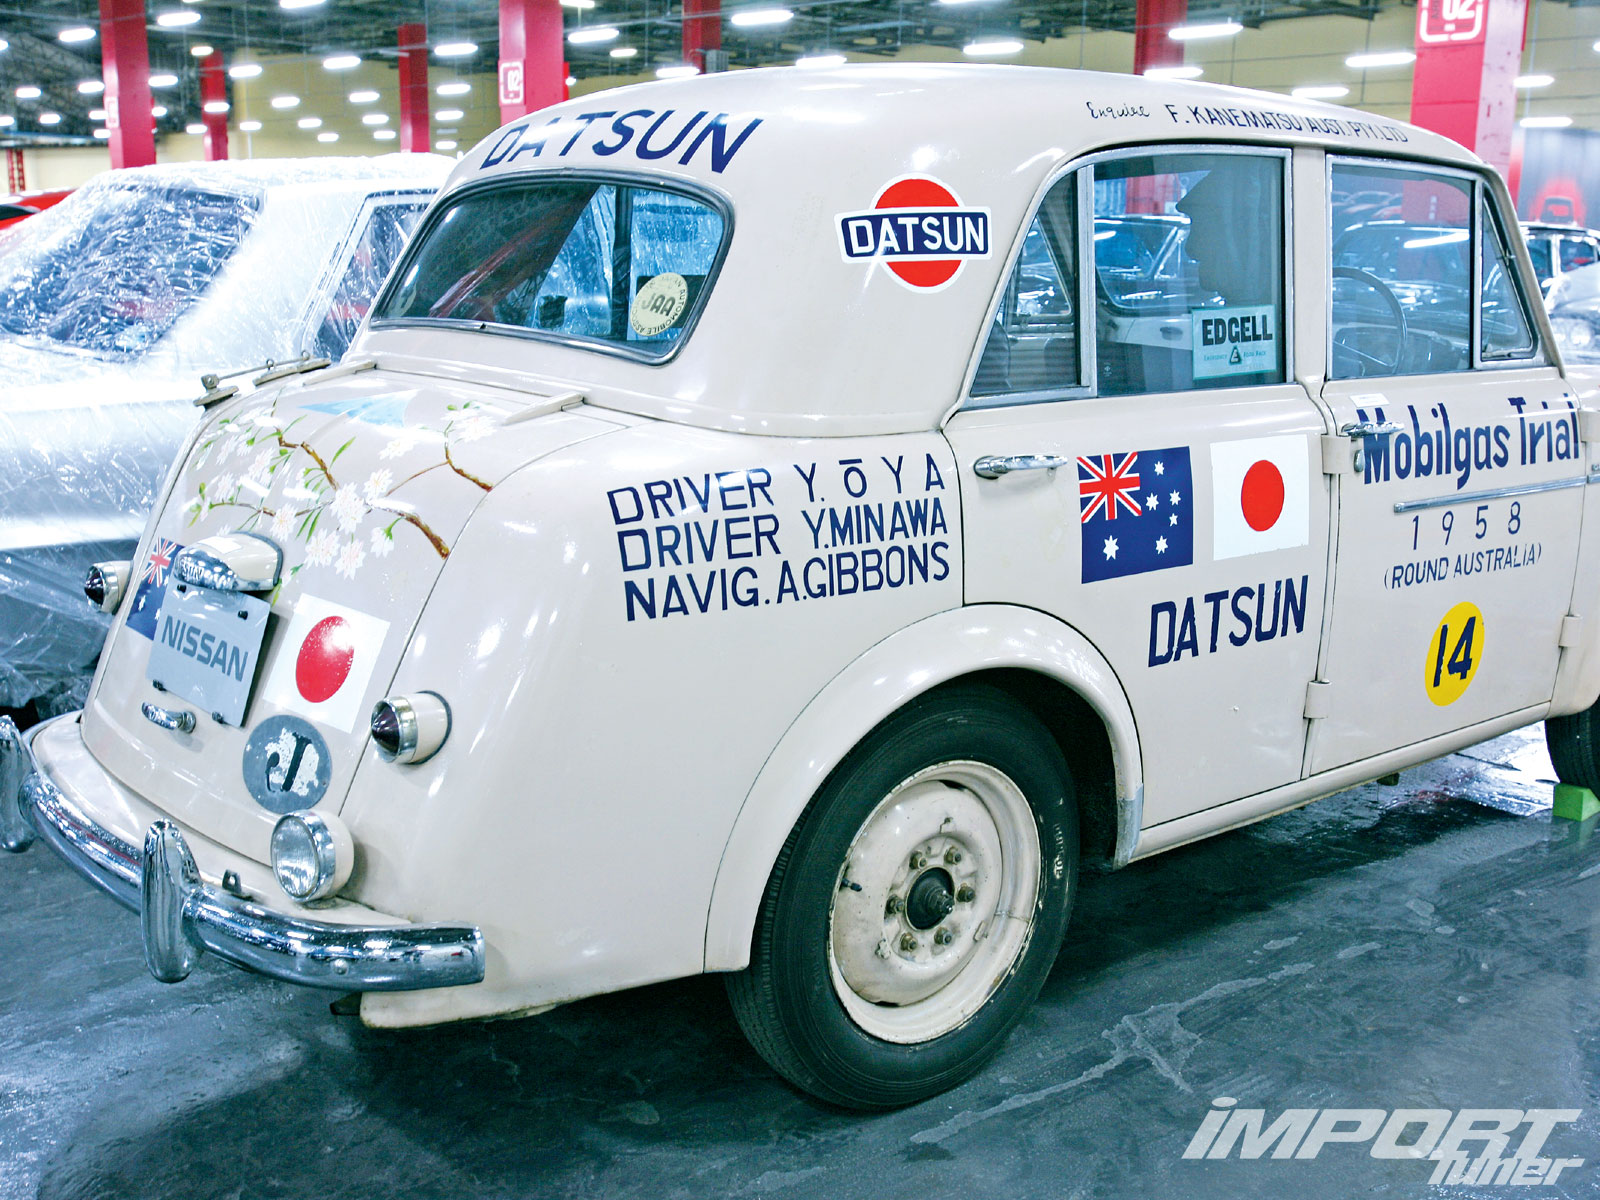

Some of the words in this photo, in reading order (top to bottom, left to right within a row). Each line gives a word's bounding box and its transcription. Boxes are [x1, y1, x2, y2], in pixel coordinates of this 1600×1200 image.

[479, 109, 764, 174] DATSUN
[847, 216, 985, 255] DATSUN
[640, 293, 676, 317] JAA
[1202, 315, 1273, 347] EDGELL
[1356, 402, 1511, 491] Mobilgas
[1507, 392, 1580, 466] Trial
[607, 467, 774, 525] DRIVER
[617, 513, 782, 572] DRIVER
[1384, 557, 1450, 590] (ROUND
[161, 615, 249, 682] NISSAN
[1148, 575, 1308, 668] DATSUN
[1433, 616, 1476, 688] 14
